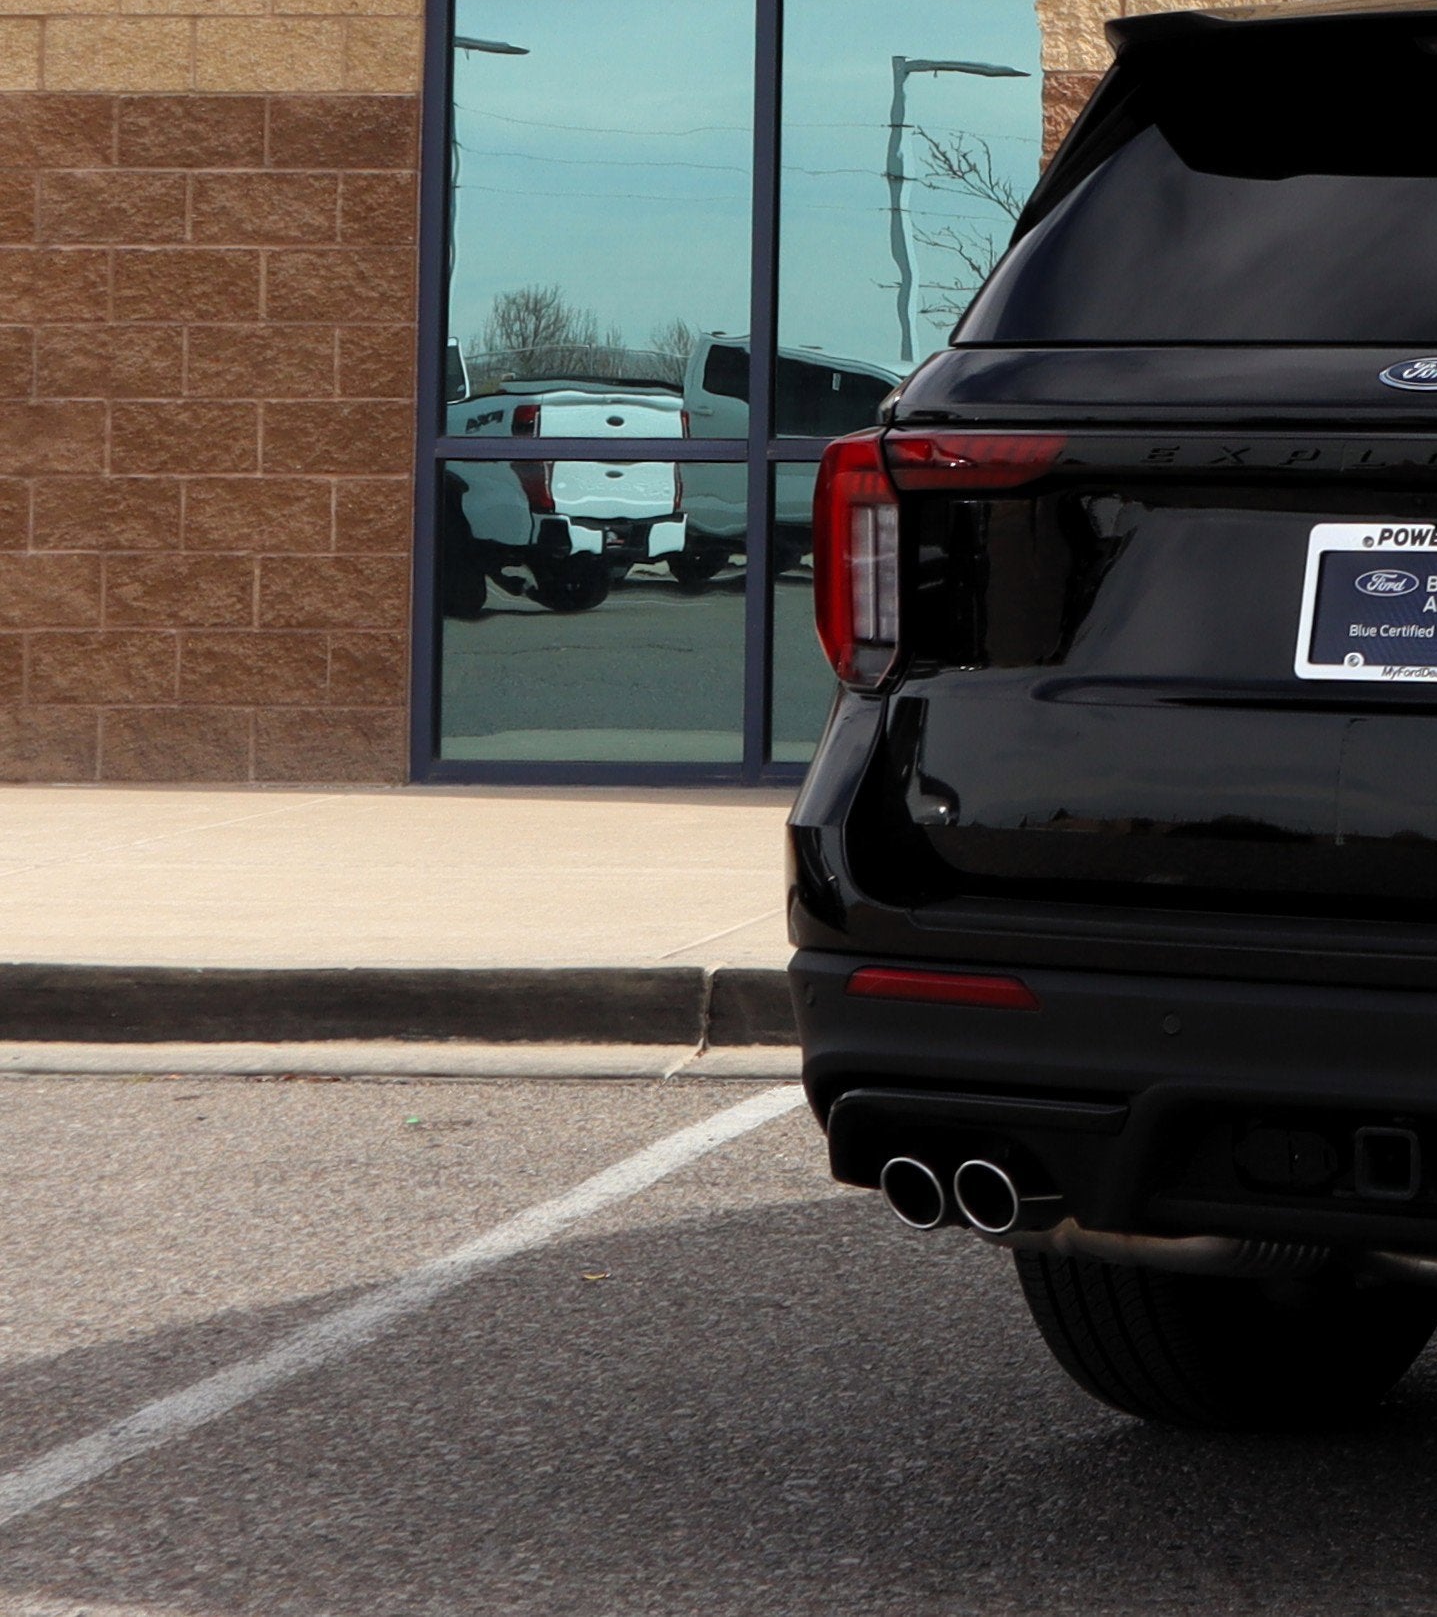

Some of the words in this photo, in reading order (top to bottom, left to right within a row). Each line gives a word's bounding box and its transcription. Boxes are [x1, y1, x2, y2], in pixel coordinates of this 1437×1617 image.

[1366, 572, 1408, 592] Ford
[1348, 624, 1377, 638] Blue
[1379, 624, 1435, 639] Certified
